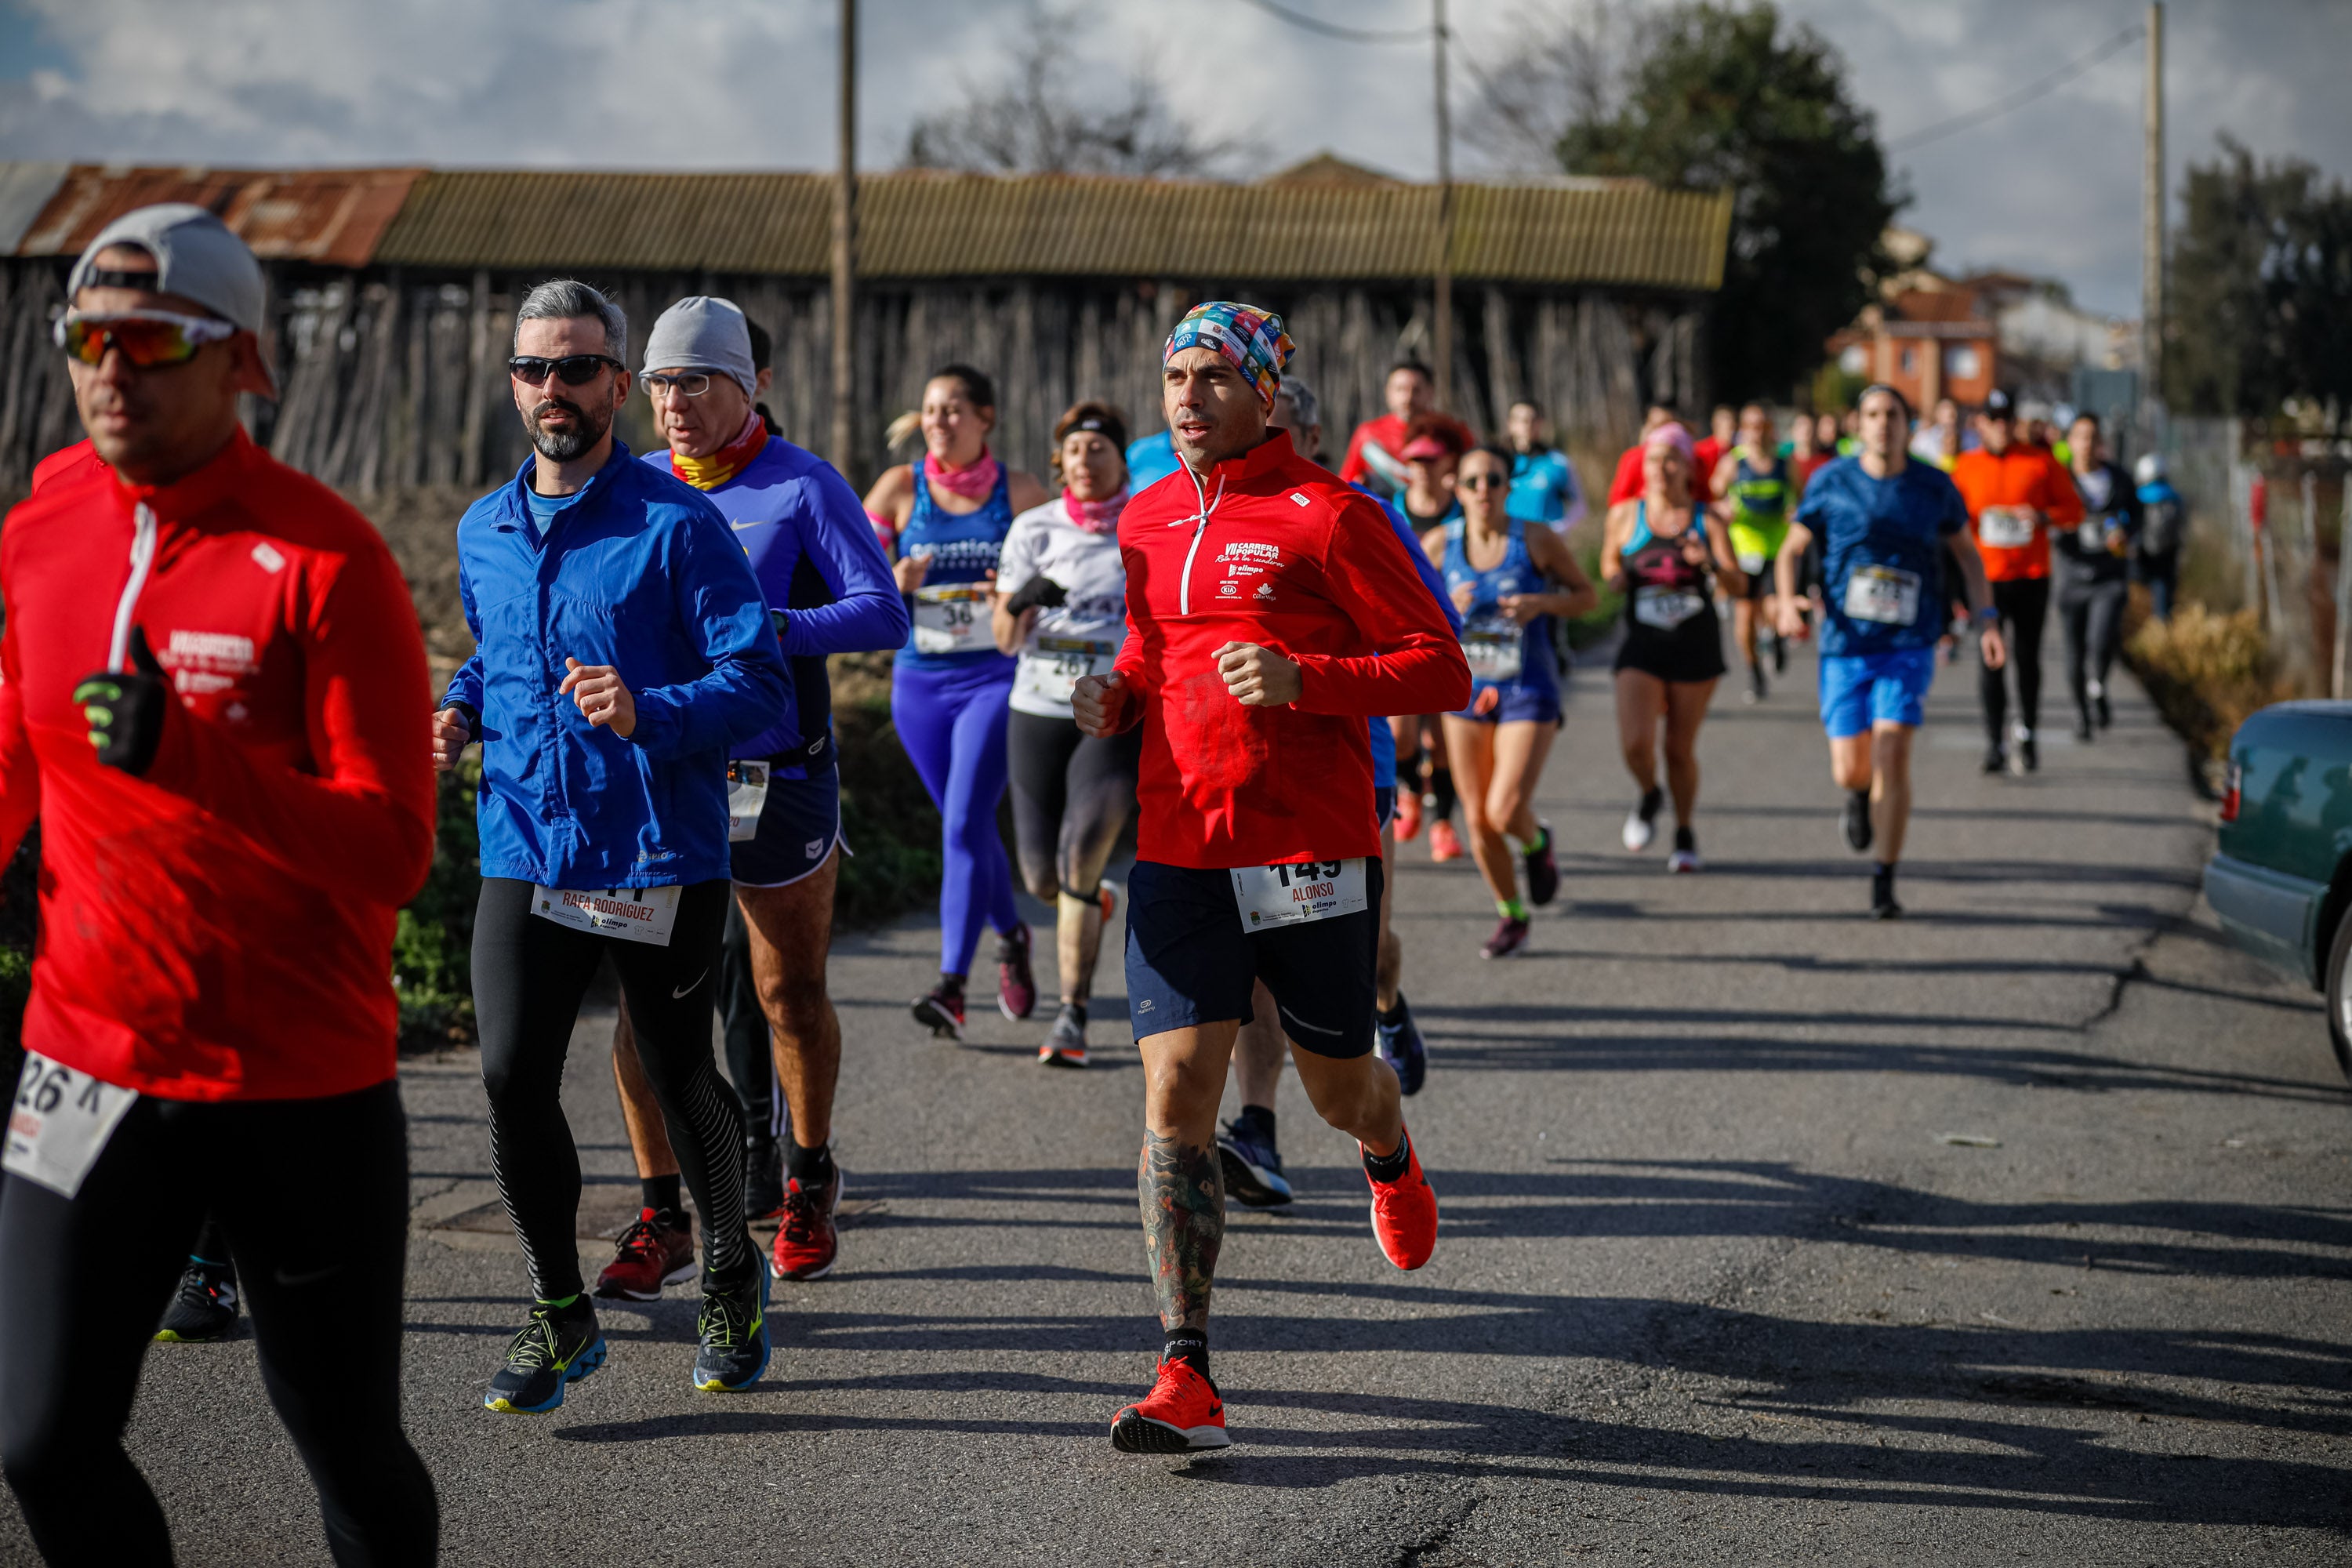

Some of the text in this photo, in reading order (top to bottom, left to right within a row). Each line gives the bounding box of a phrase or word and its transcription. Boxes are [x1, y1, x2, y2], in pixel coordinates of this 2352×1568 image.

[1225, 543, 1238, 556] VII
[1237, 543, 1279, 554] CARRERA
[1236, 549, 1279, 560] POPULAR
[1237, 564, 1264, 574] olimpo
[1292, 881, 1334, 902] ALONSO
[561, 891, 590, 910] RAFA
[593, 898, 655, 922] RODRÍGUEZ
[1312, 900, 1337, 909] olimpo
[601, 918, 628, 928] olimpo
